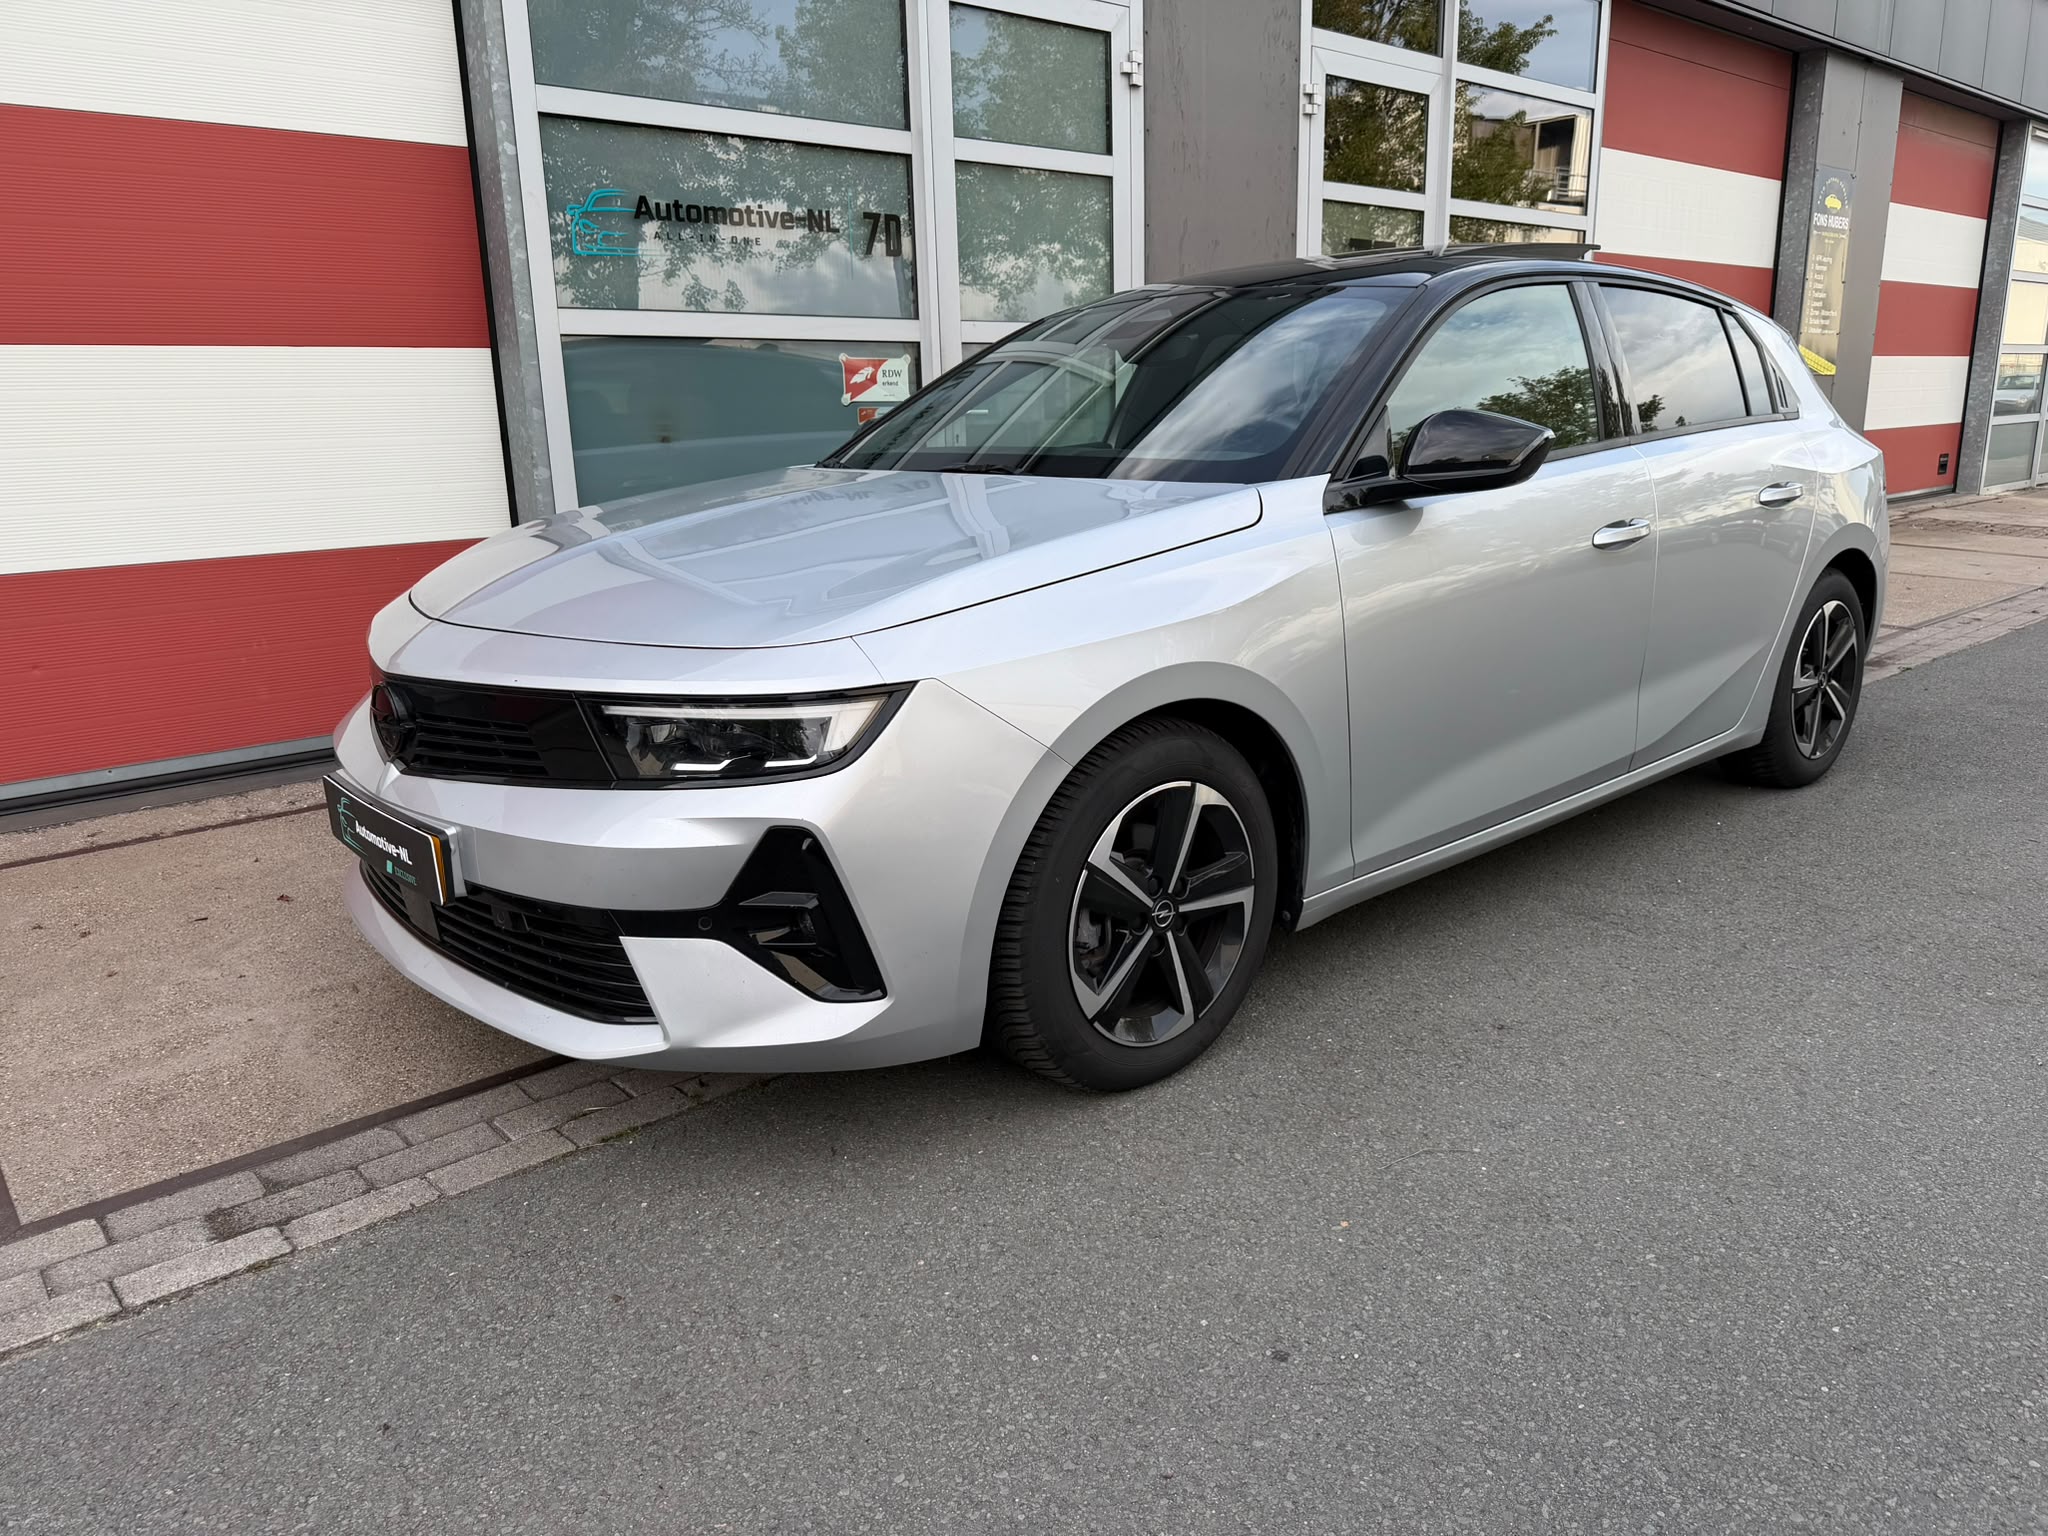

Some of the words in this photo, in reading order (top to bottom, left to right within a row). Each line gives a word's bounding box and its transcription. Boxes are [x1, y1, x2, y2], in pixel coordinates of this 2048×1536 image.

[634, 195, 840, 233] Automotive-NL
[1813, 212, 1828, 227] FONS
[1828, 214, 1849, 230] HUBERS
[863, 211, 903, 257] 7D
[882, 369, 902, 378] RDW
[355, 820, 413, 866] Automotive-NL
